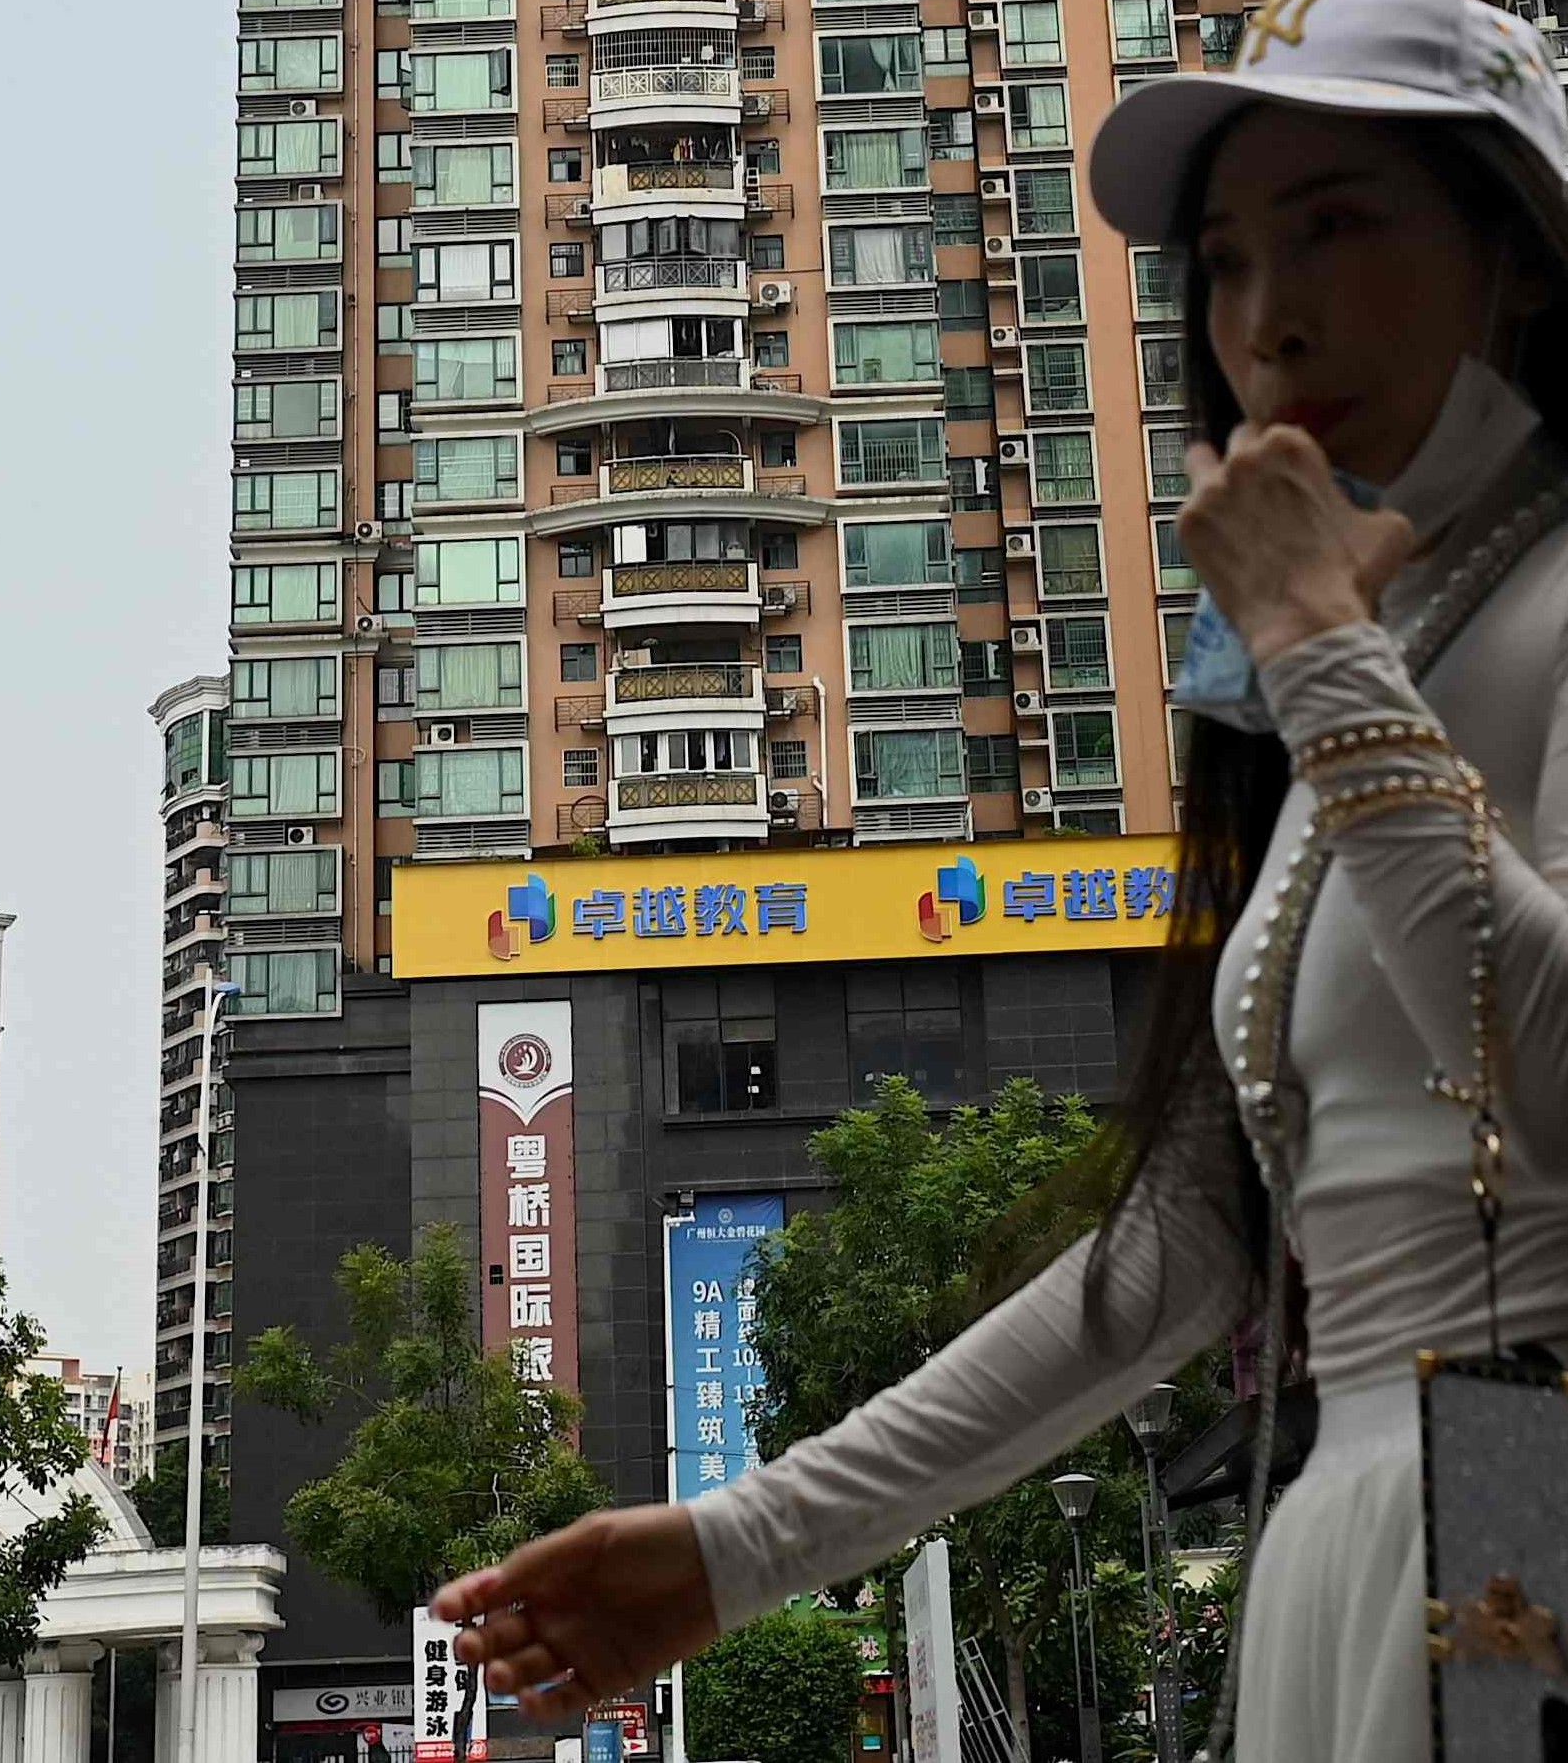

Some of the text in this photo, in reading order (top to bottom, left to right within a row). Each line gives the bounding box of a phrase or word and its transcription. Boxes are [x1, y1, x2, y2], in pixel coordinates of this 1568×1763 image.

[572, 880, 810, 940] 卓越教育
[1003, 865, 1205, 922] 卓越教
[506, 1134, 553, 1466] 粤桥国际旅
[691, 1279, 727, 1496] 9A精工臻筑美
[355, 1689, 413, 1706] 兴业银
[424, 1639, 449, 1737] 健身游泳
